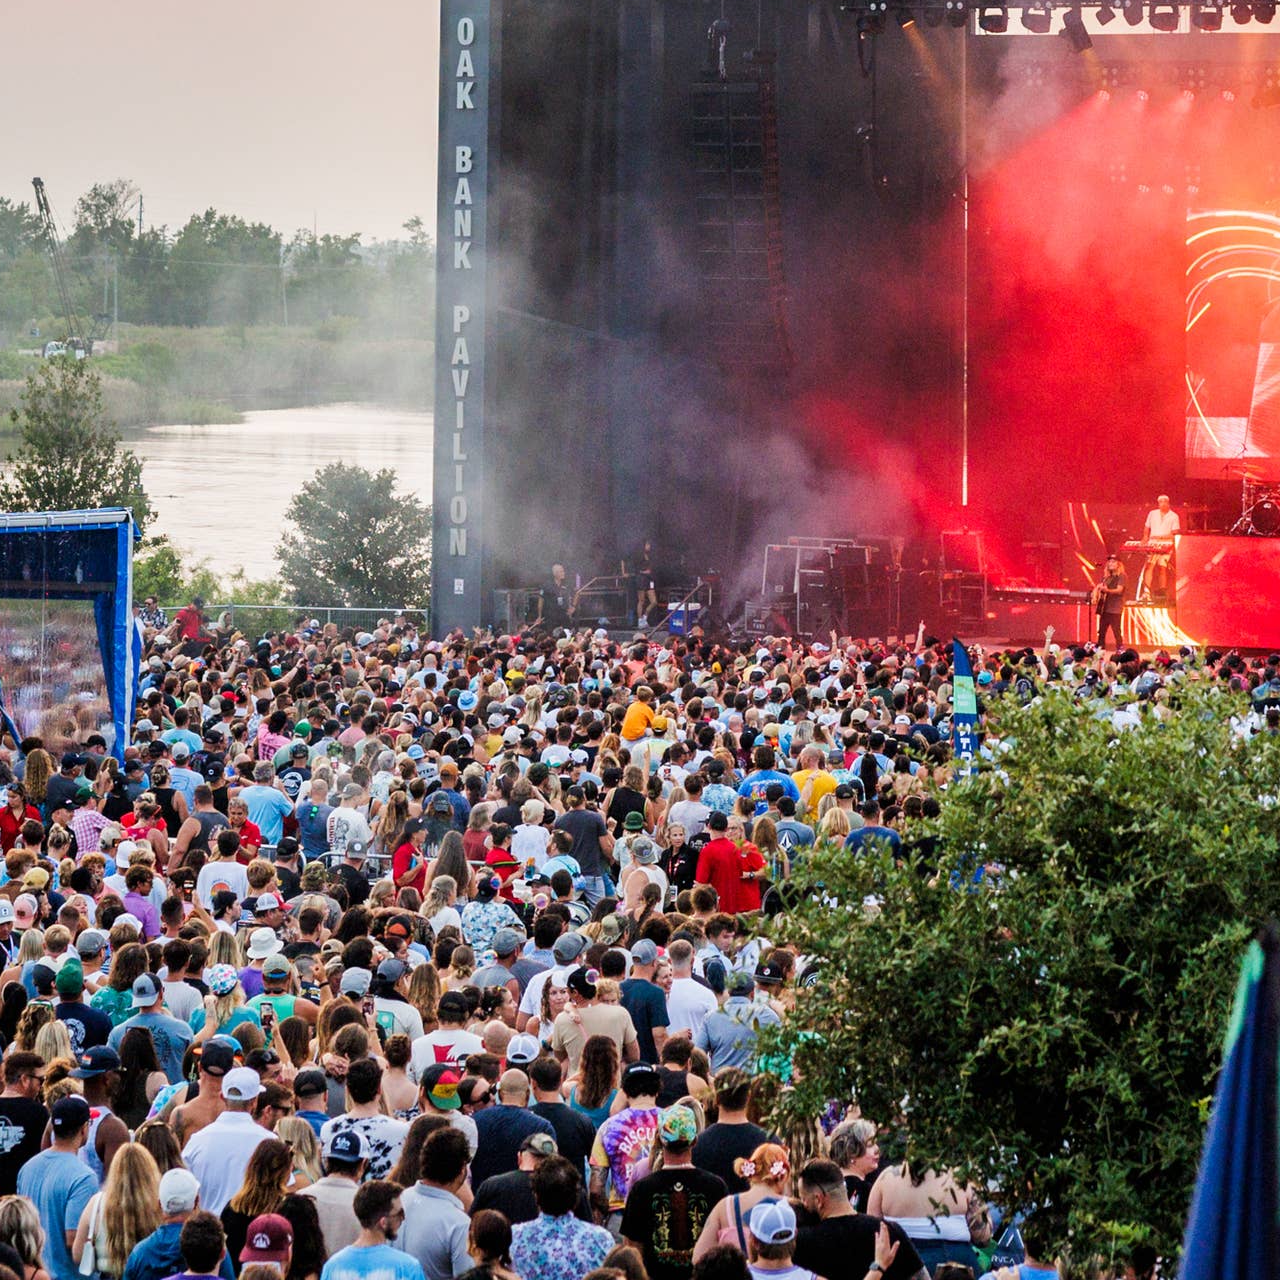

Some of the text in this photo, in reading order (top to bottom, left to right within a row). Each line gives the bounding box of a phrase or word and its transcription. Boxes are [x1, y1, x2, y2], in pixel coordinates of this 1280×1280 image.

[455, 16, 475, 111] OAK
[453, 144, 473, 271] BANK
[449, 304, 471, 557] PAVILION
[618, 1127, 656, 1155] BISCU
